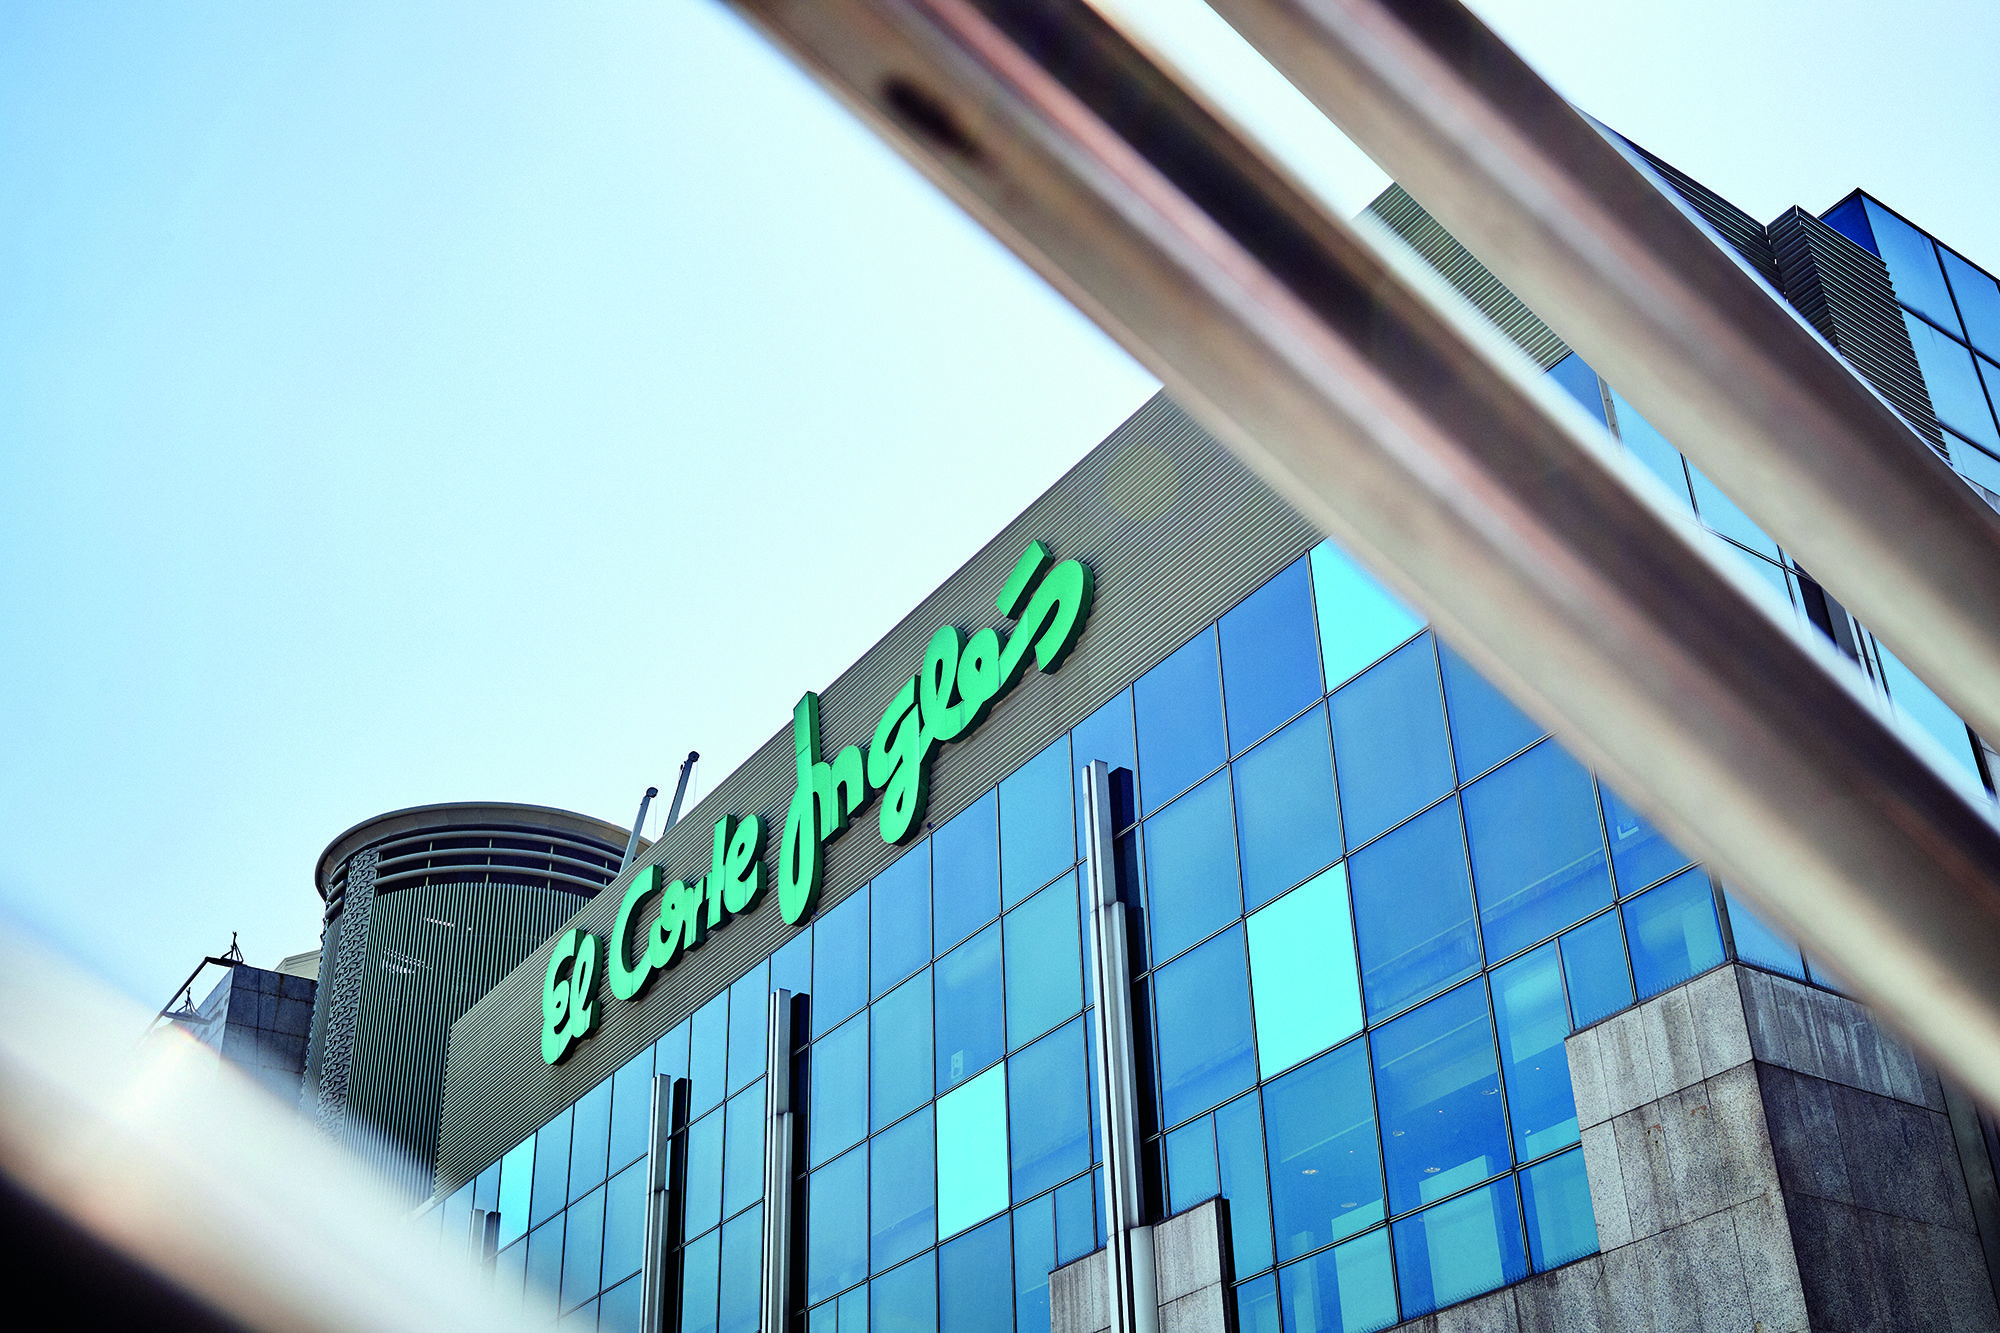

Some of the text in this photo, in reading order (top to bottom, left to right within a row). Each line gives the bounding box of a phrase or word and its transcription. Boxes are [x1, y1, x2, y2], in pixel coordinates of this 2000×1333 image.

[541, 539, 1095, 1066] El Corte Inglés
